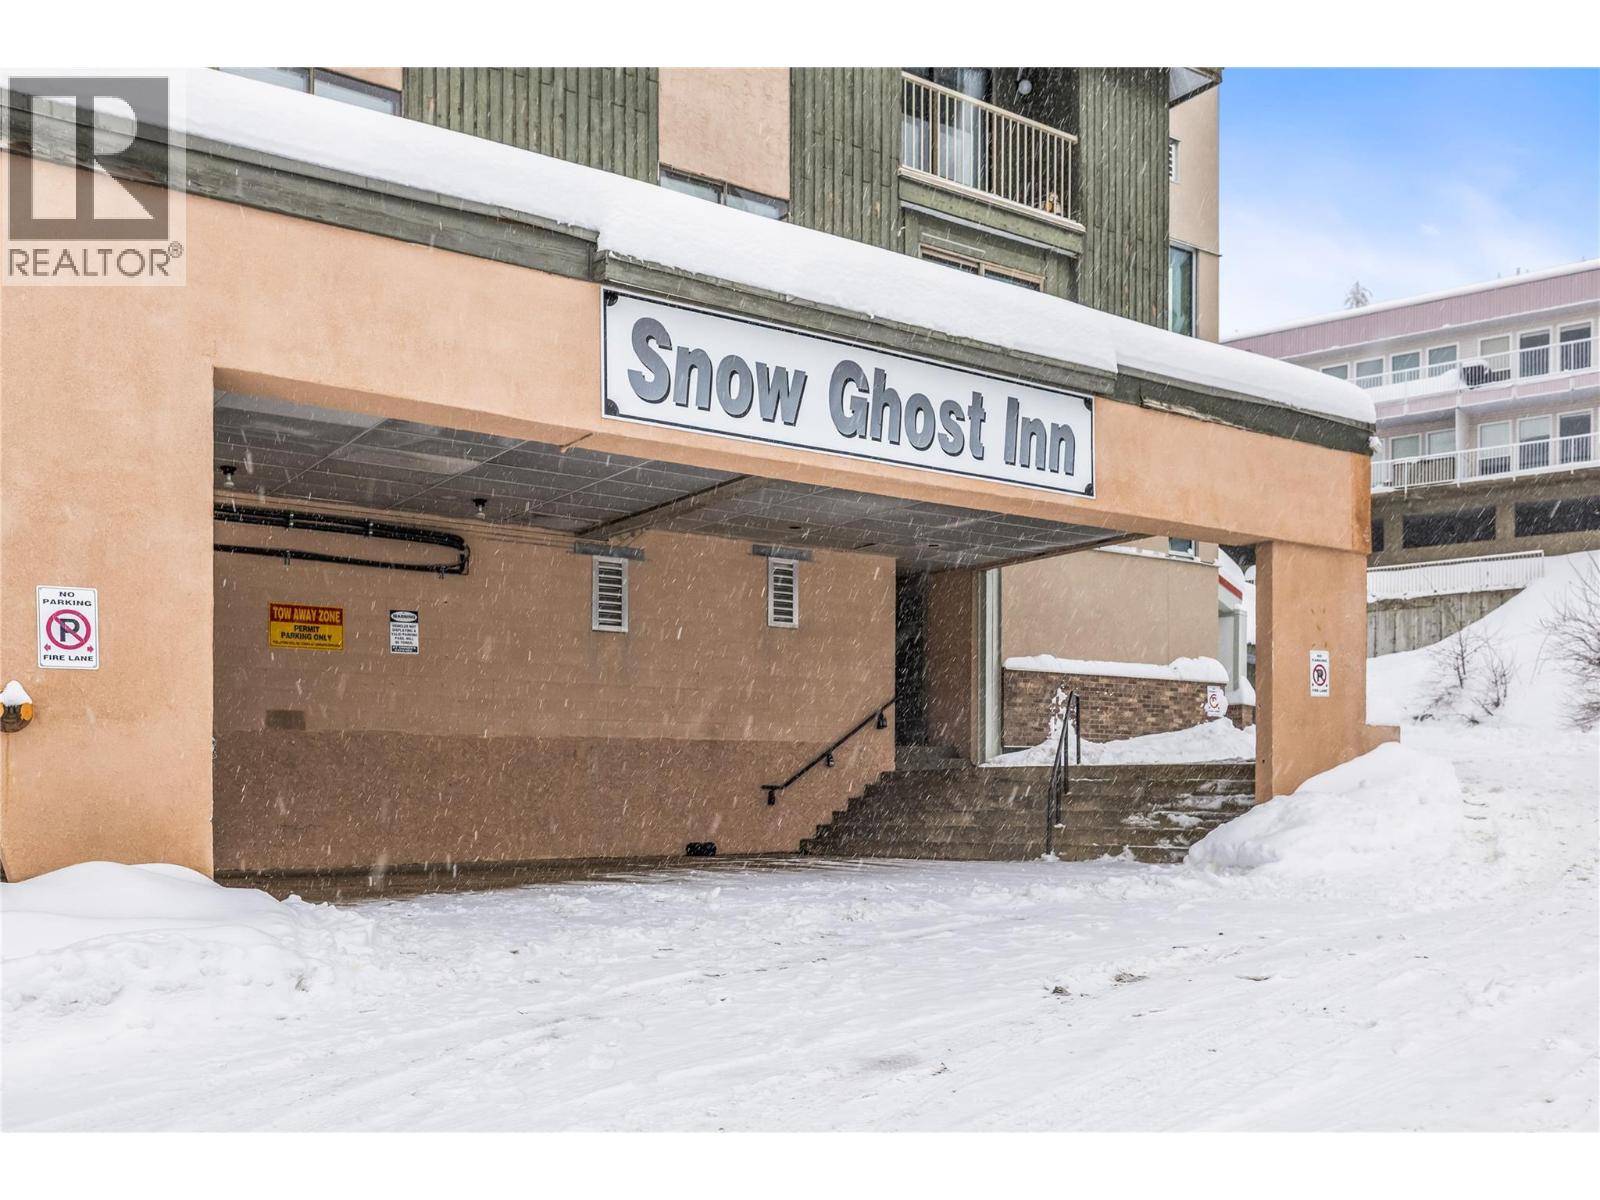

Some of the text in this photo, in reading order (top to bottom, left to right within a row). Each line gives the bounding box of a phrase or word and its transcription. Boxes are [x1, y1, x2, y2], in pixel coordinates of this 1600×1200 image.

[627, 317, 1076, 477] Snow Ghost Inn
[272, 606, 340, 623] TOW AWAY ZONE
[294, 624, 320, 633] PERMIT
[281, 632, 333, 642] PARKING ONLY
